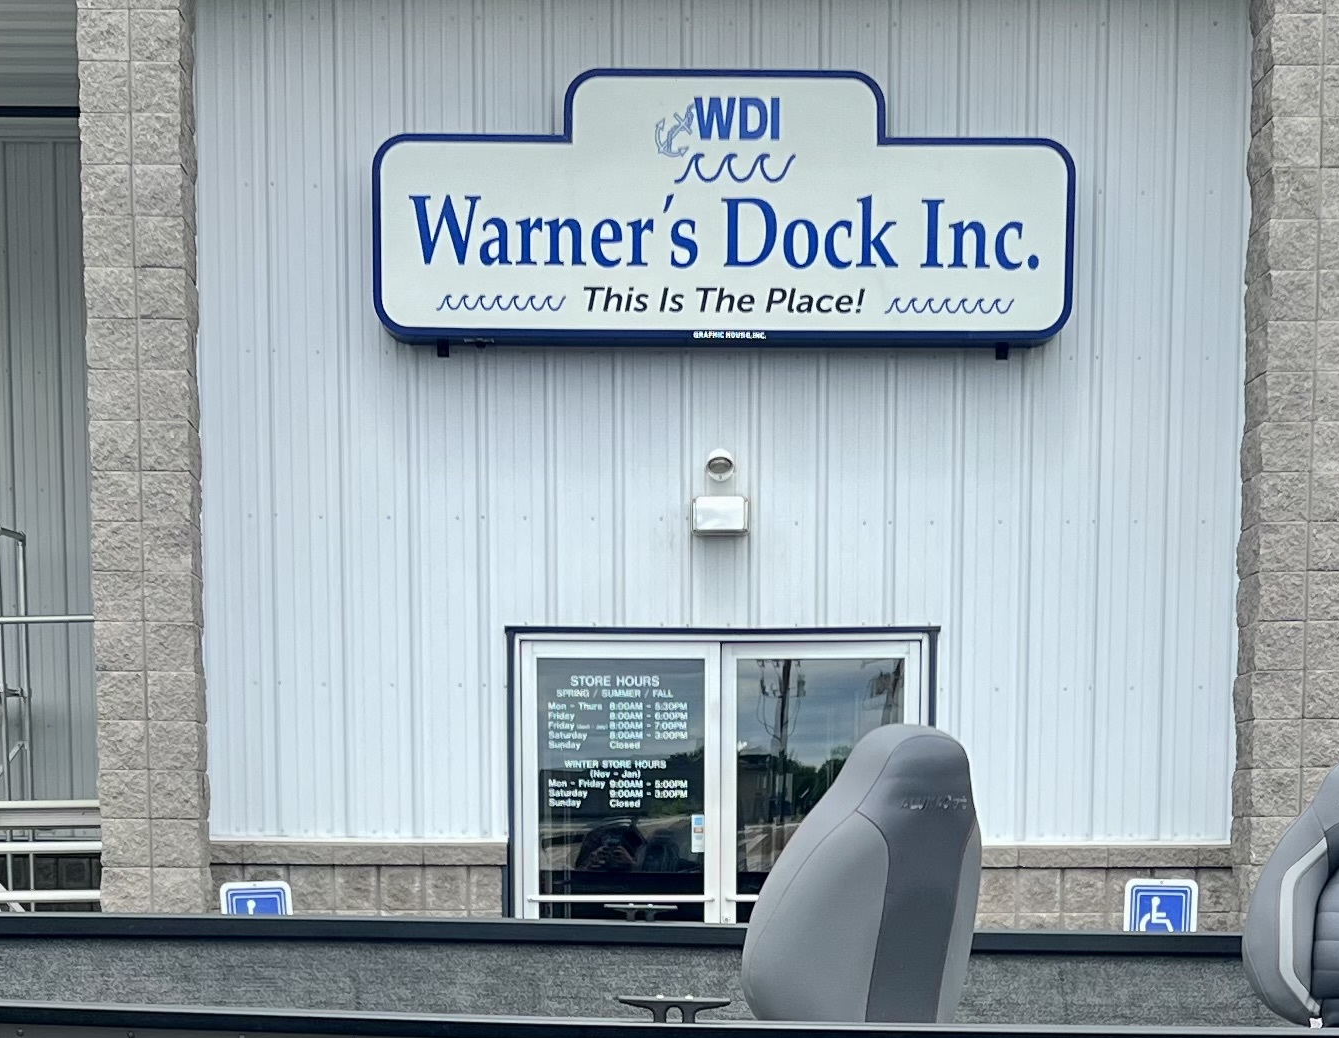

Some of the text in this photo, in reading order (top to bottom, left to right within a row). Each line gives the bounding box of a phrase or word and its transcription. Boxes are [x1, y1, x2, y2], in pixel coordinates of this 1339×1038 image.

[693, 96, 781, 141] WDI
[408, 194, 1041, 271] Warner's Dock Inc.
[583, 286, 867, 314] This Is The Place!
[570, 675, 660, 687] STORE HOURS
[556, 689, 590, 698] SPRING
[601, 689, 641, 698] SUMMER
[652, 689, 674, 698] FALL
[547, 702, 567, 711] Mon
[578, 702, 603, 711] Thurs
[547, 712, 575, 721] Friday
[547, 721, 575, 731] Friday
[654, 721, 687, 730] 7:00PM
[548, 731, 588, 741] Saturday
[654, 731, 688, 740] 3:00PM
[548, 741, 641, 751] Sunday Closed
[564, 760, 667, 769] WINTER STORE HOURS
[590, 769, 611, 779] (Nov
[621, 769, 641, 779] Jan)
[548, 779, 568, 788] Mon
[578, 779, 606, 789] Friday
[548, 789, 588, 799] Saturday
[548, 799, 641, 808] Sunday Closed
